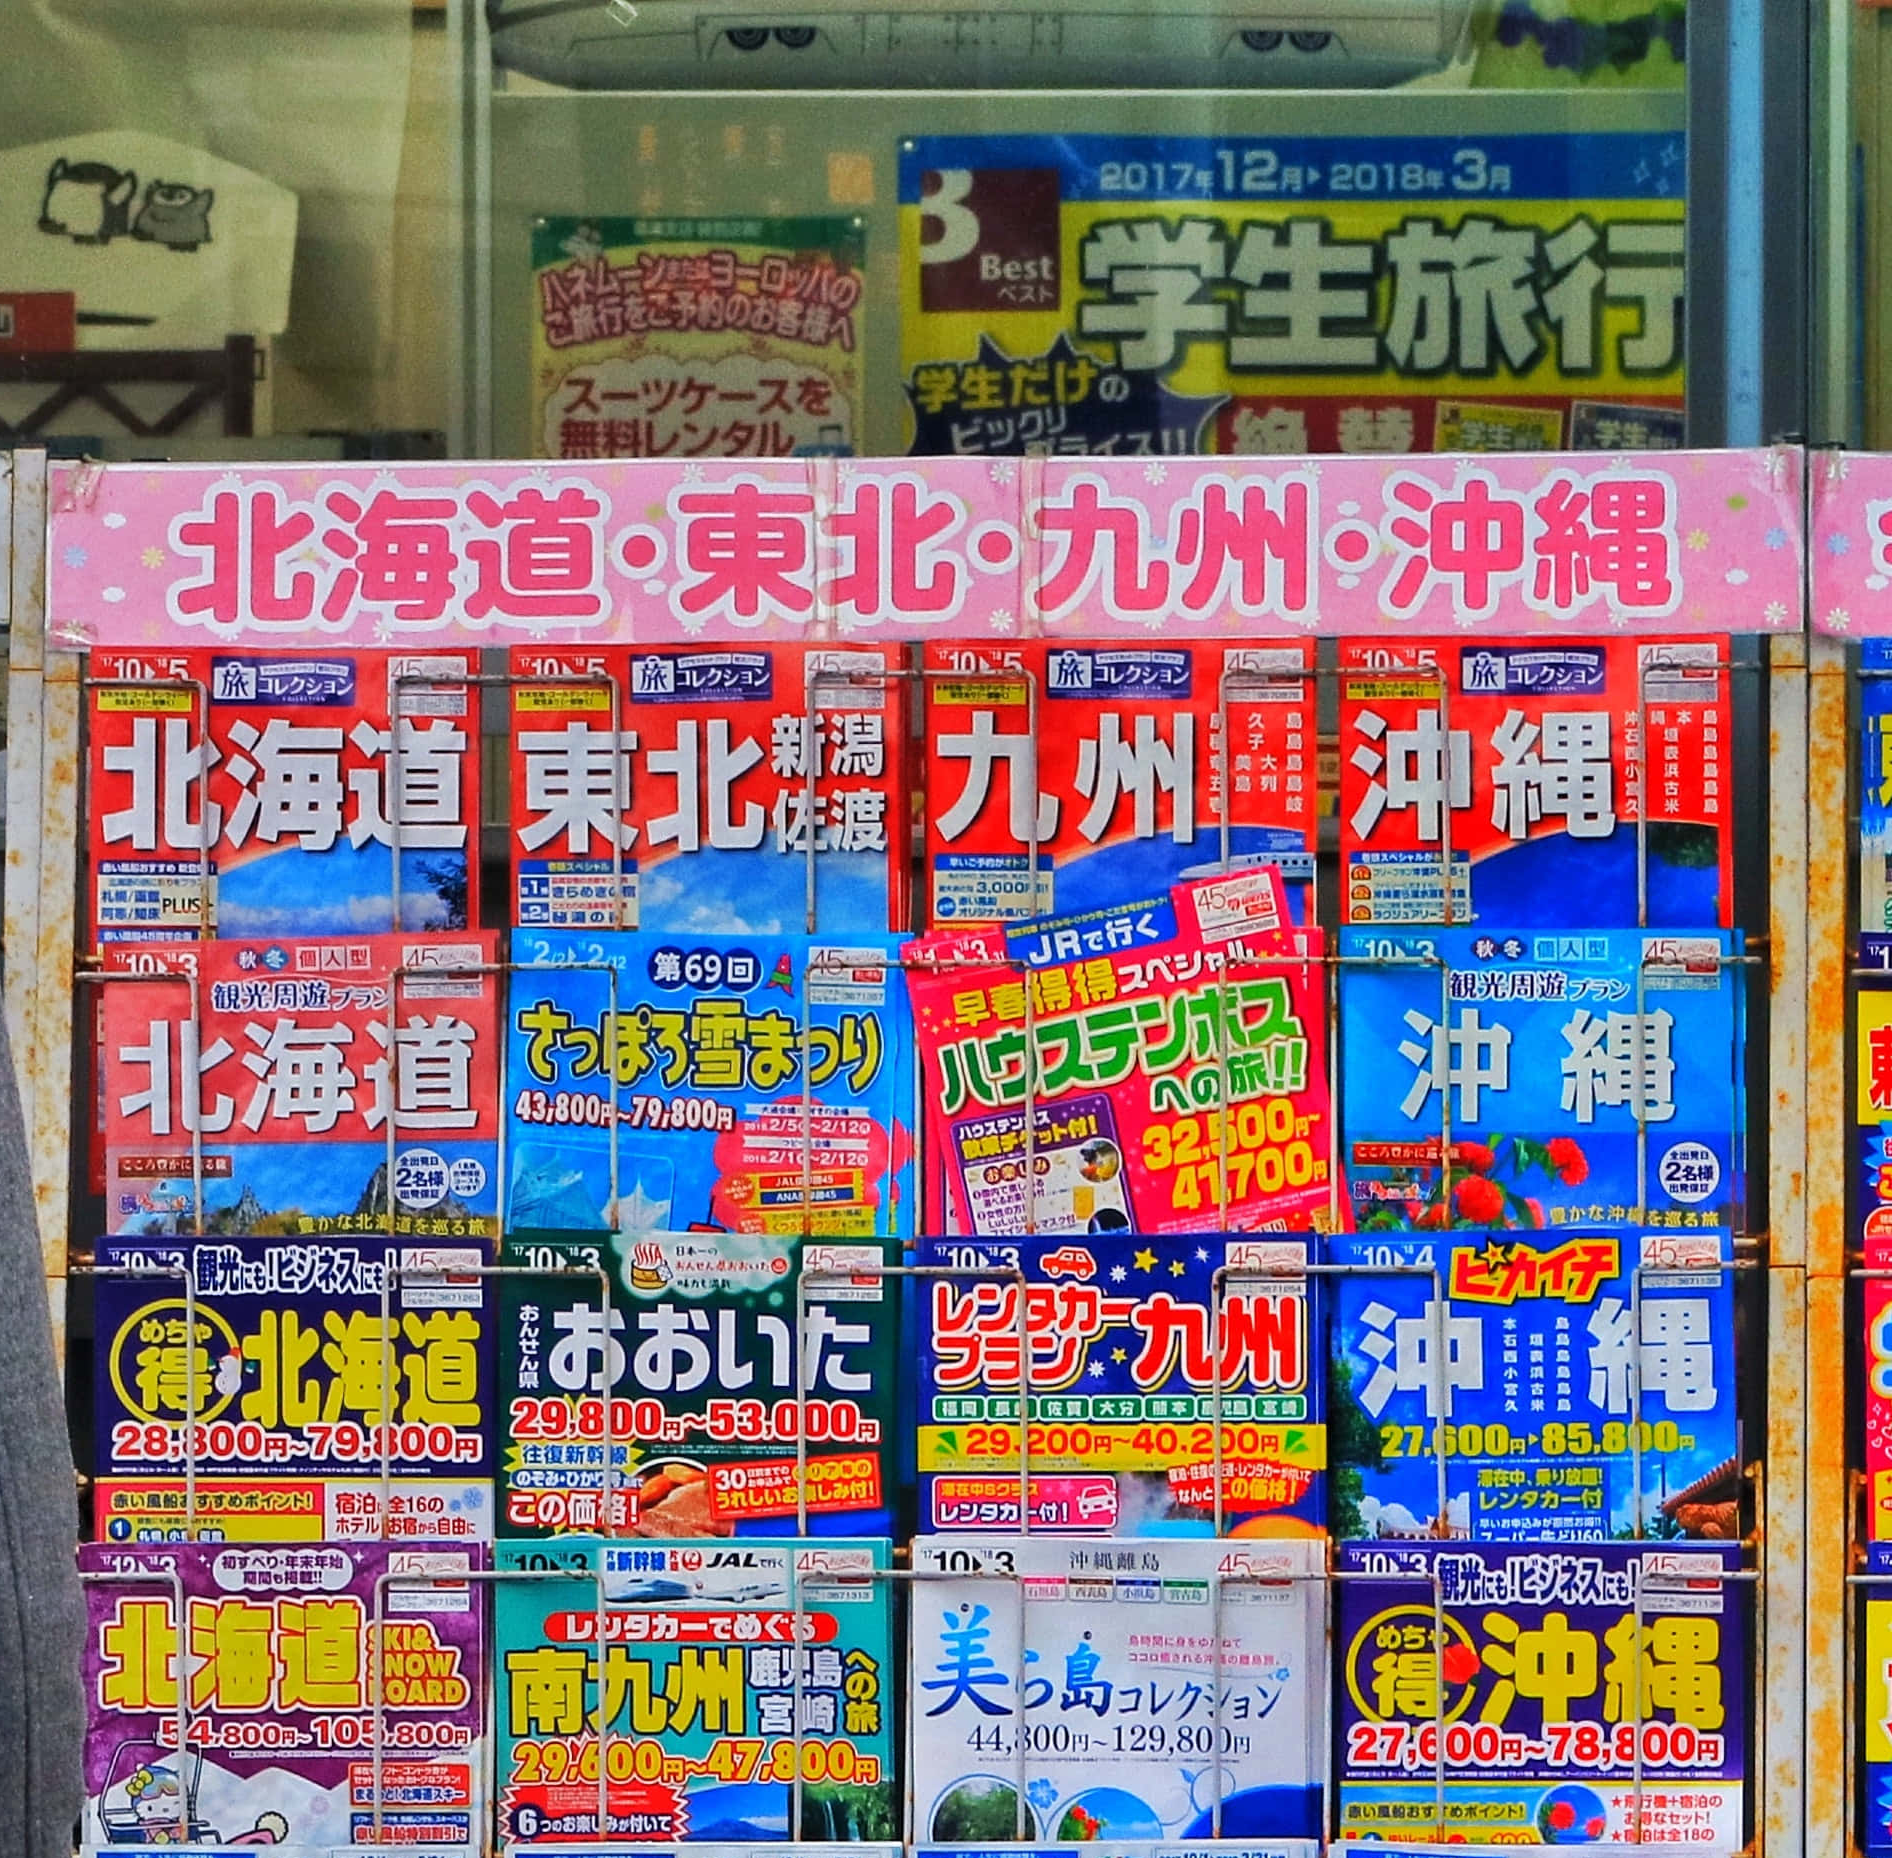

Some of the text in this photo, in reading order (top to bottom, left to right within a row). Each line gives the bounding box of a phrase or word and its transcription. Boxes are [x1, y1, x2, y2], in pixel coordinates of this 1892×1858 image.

[979, 252, 1055, 282] Best
[996, 287, 1053, 304] ベスト
[1077, 217, 1685, 377] 学生旅行
[561, 375, 832, 416] スーツケースを
[102, 719, 467, 850] 北海道
[519, 719, 764, 851] 東北
[938, 713, 1194, 845] 九州
[1352, 709, 1615, 842] 沖縄
[656, 953, 755, 986] 第69回
[1027, 911, 1162, 967] JRで行く
[120, 1017, 479, 1135] 北海道
[521, 1001, 883, 1092] さっぽろ雪まつり
[942, 979, 1302, 1115] ハウステンボス
[1400, 1010, 1677, 1124] 沖縄
[397, 1168, 445, 1187] 2名様
[1665, 1161, 1714, 1182] 2名様
[550, 1303, 872, 1393] おおいた
[933, 1283, 1133, 1336] レンタカー
[1132, 1294, 1305, 1391] 九州
[241, 1311, 483, 1428] 北海道
[1070, 1553, 1160, 1571] 沖縄離島
[102, 1598, 364, 1714] 北海道
[565, 1612, 816, 1641] レンタカーでめぐる
[505, 1648, 744, 1737] 南九州
